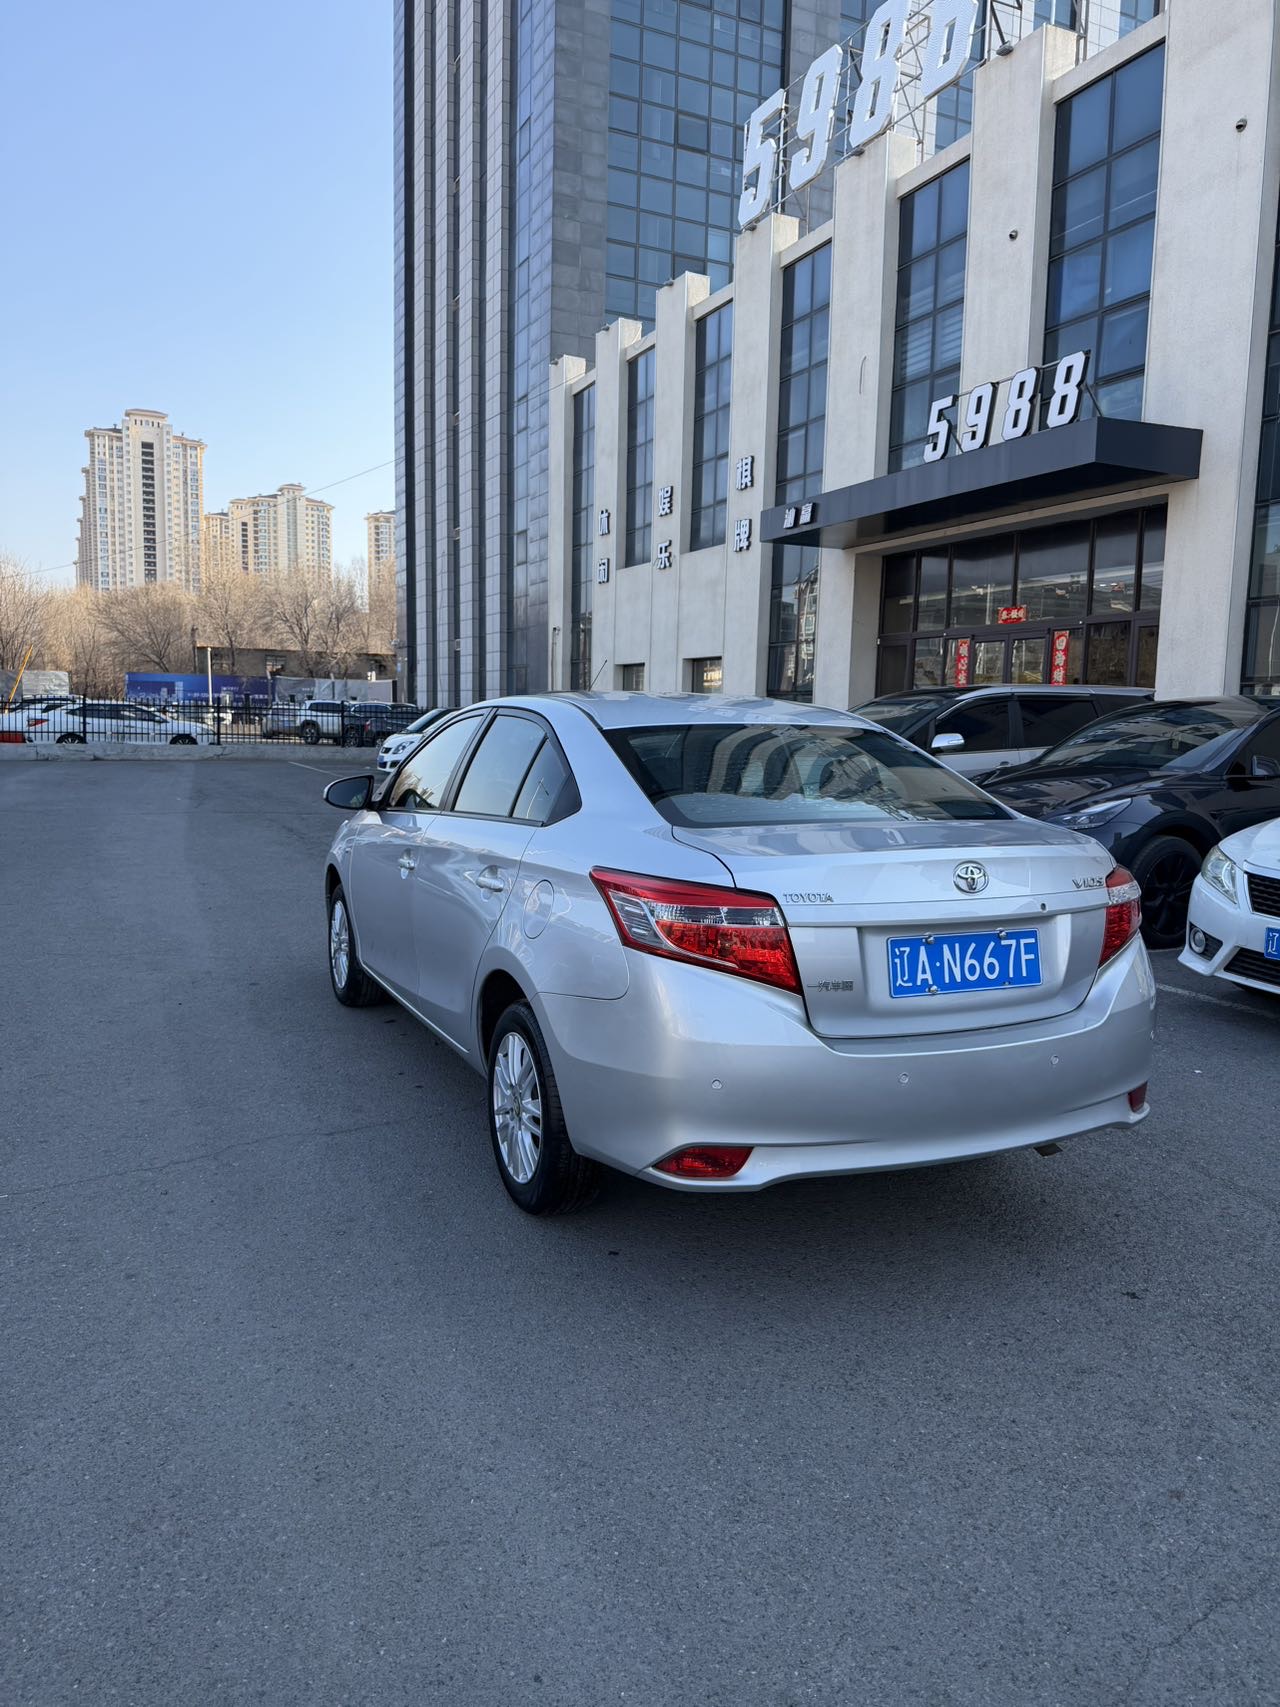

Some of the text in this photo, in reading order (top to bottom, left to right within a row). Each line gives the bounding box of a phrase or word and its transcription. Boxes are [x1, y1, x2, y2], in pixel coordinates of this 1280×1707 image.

[923, 350, 1091, 463] 5988
[657, 486, 673, 569] 娱乐
[735, 456, 753, 552] 棋牌
[598, 509, 610, 584] 休闲
[783, 892, 834, 903] TOYOTA
